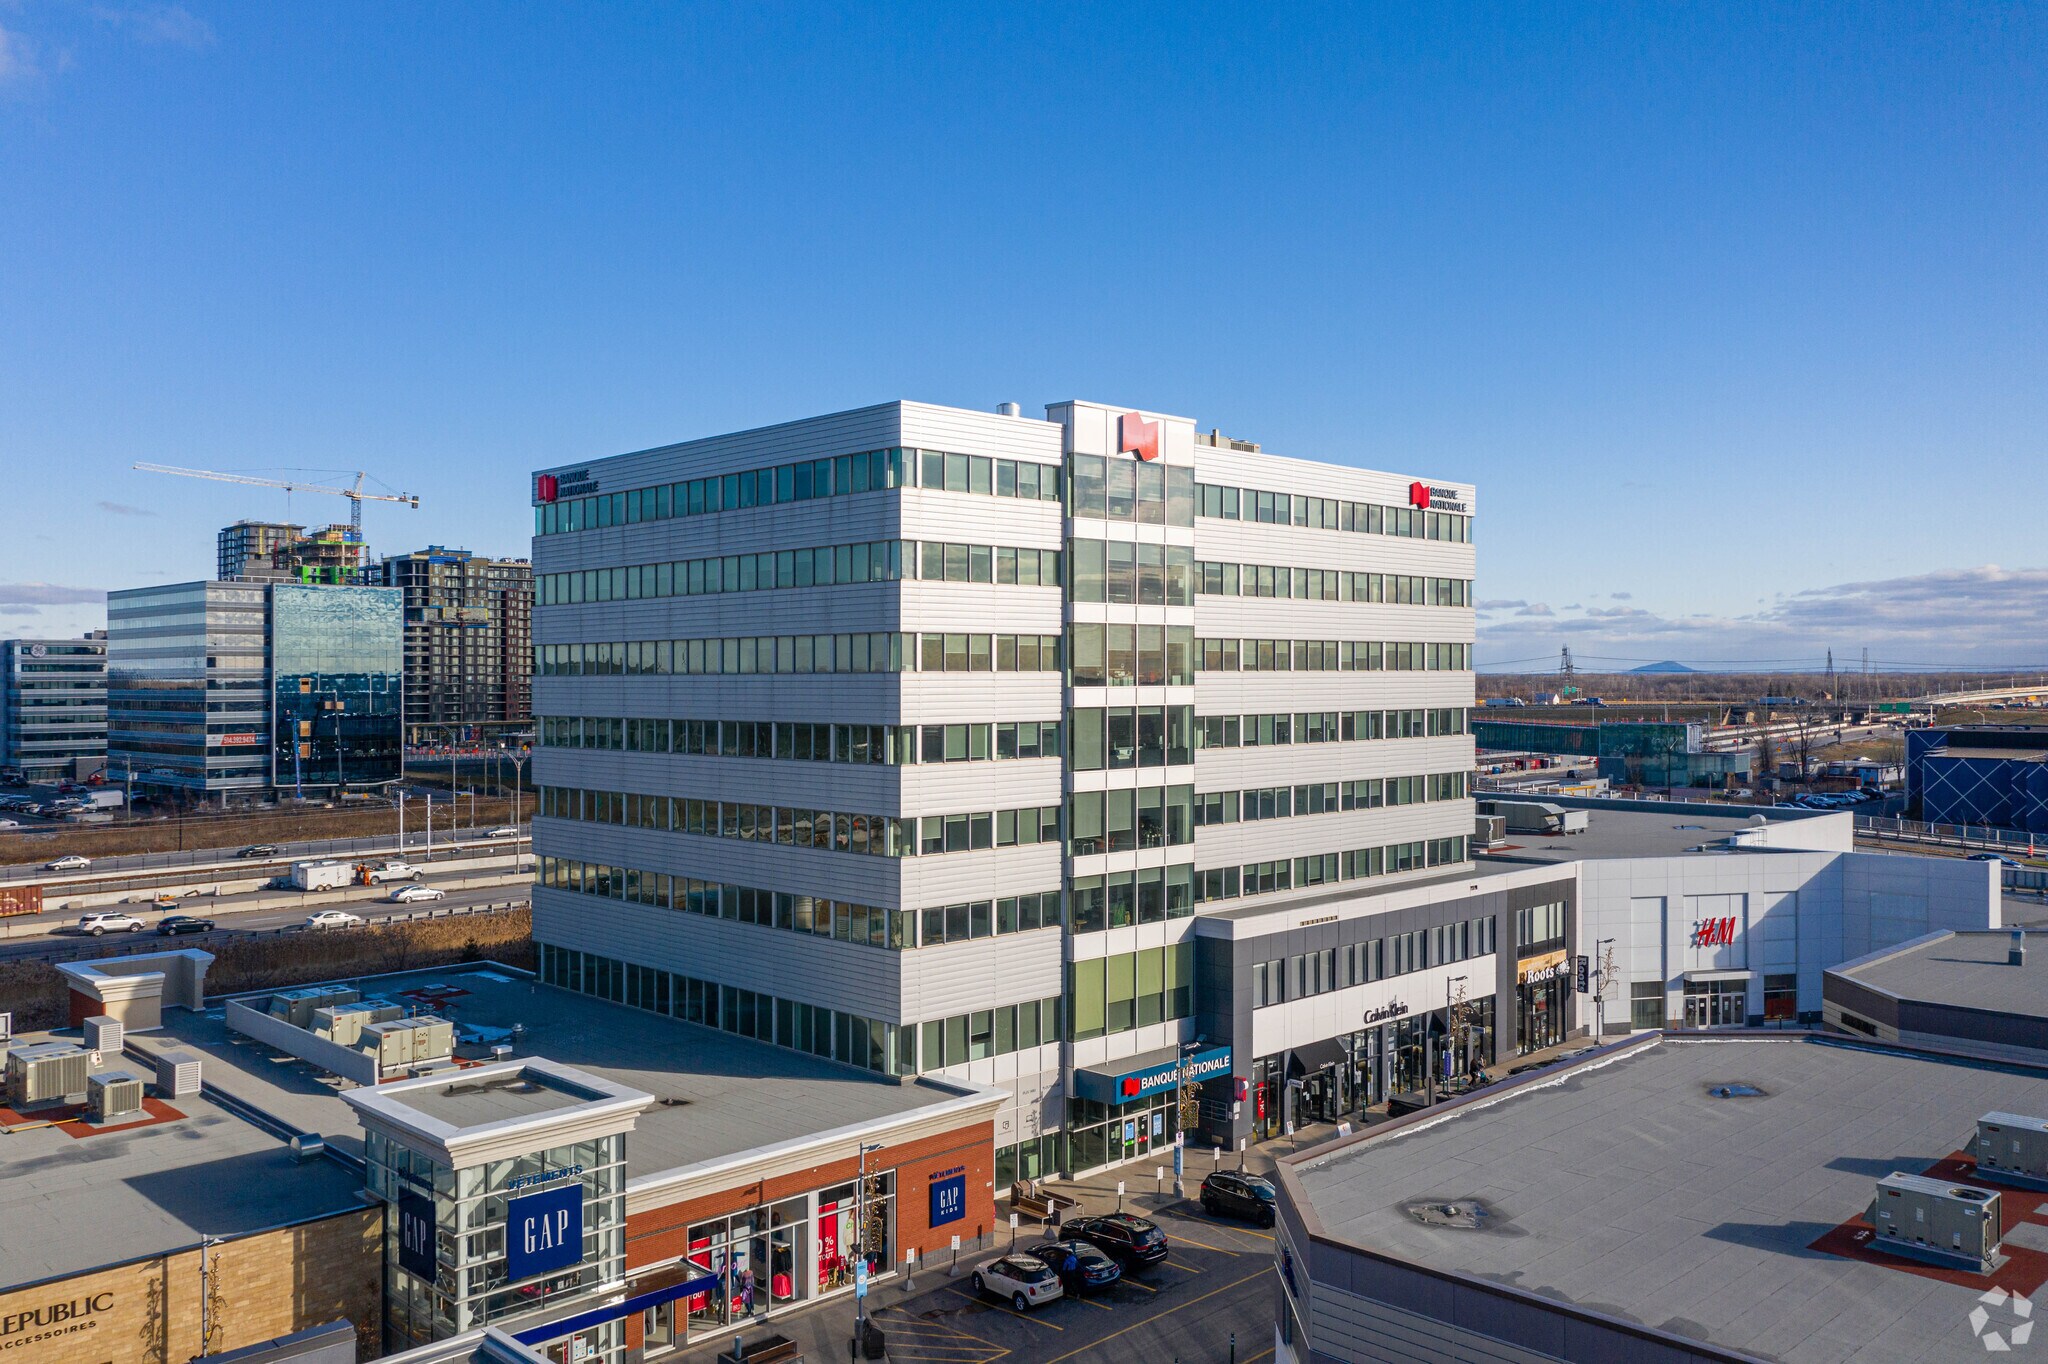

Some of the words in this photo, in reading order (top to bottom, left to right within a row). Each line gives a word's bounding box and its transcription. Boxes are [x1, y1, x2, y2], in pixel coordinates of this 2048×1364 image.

[1429, 499, 1467, 513] NATIONALE
[1430, 487, 1458, 500] BANQUE
[1697, 916, 1736, 947] H&M
[1527, 967, 1555, 984] Roots
[1578, 957, 1587, 993] Roots
[1141, 1069, 1178, 1090] BANQUE
[1182, 1055, 1230, 1079] NATIONALE
[940, 1186, 959, 1208] GAP
[940, 1205, 958, 1216] KIDS
[404, 1211, 427, 1256] GAP
[524, 1209, 569, 1254] GAP
[0, 1292, 114, 1336] EPUBLIC
[0, 1320, 97, 1351] CCESSOIRES
